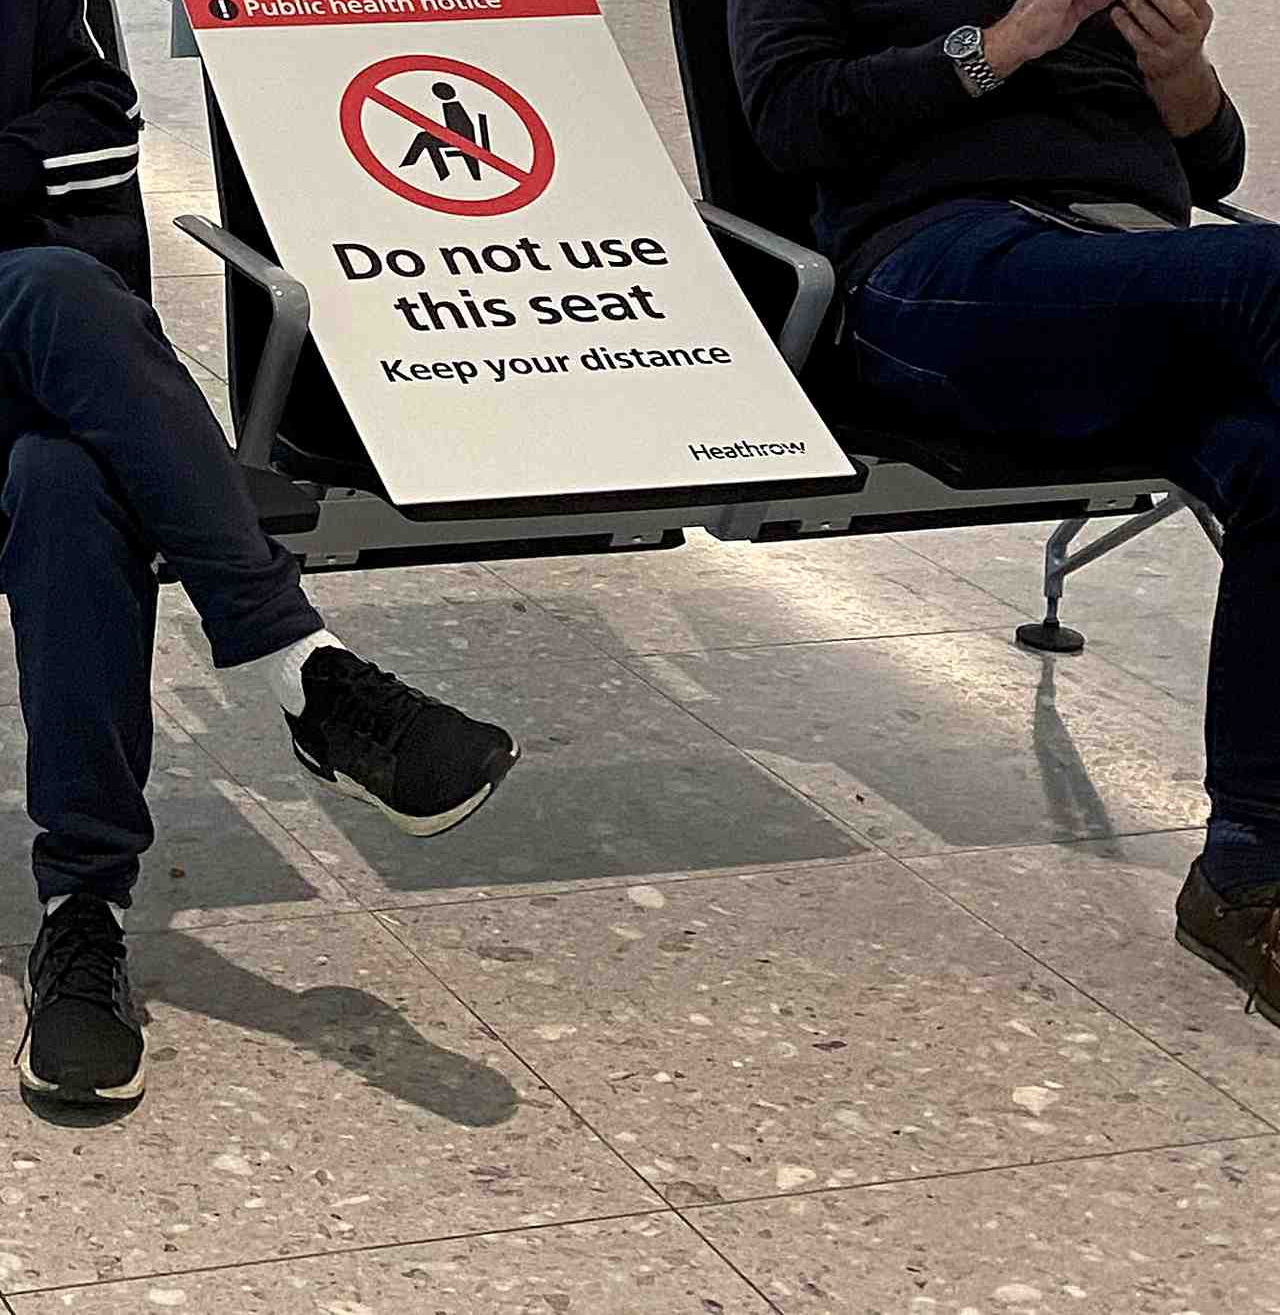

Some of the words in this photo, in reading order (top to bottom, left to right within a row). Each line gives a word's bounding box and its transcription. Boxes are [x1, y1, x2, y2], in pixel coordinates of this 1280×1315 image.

[331, 243, 426, 281] Do
[438, 237, 553, 276] not
[558, 237, 669, 270] use
[393, 289, 517, 332] this
[528, 284, 666, 325] seat
[379, 359, 478, 385] Keep
[482, 354, 570, 383] your
[580, 346, 732, 371] distance
[687, 440, 806, 461] Heathrow
